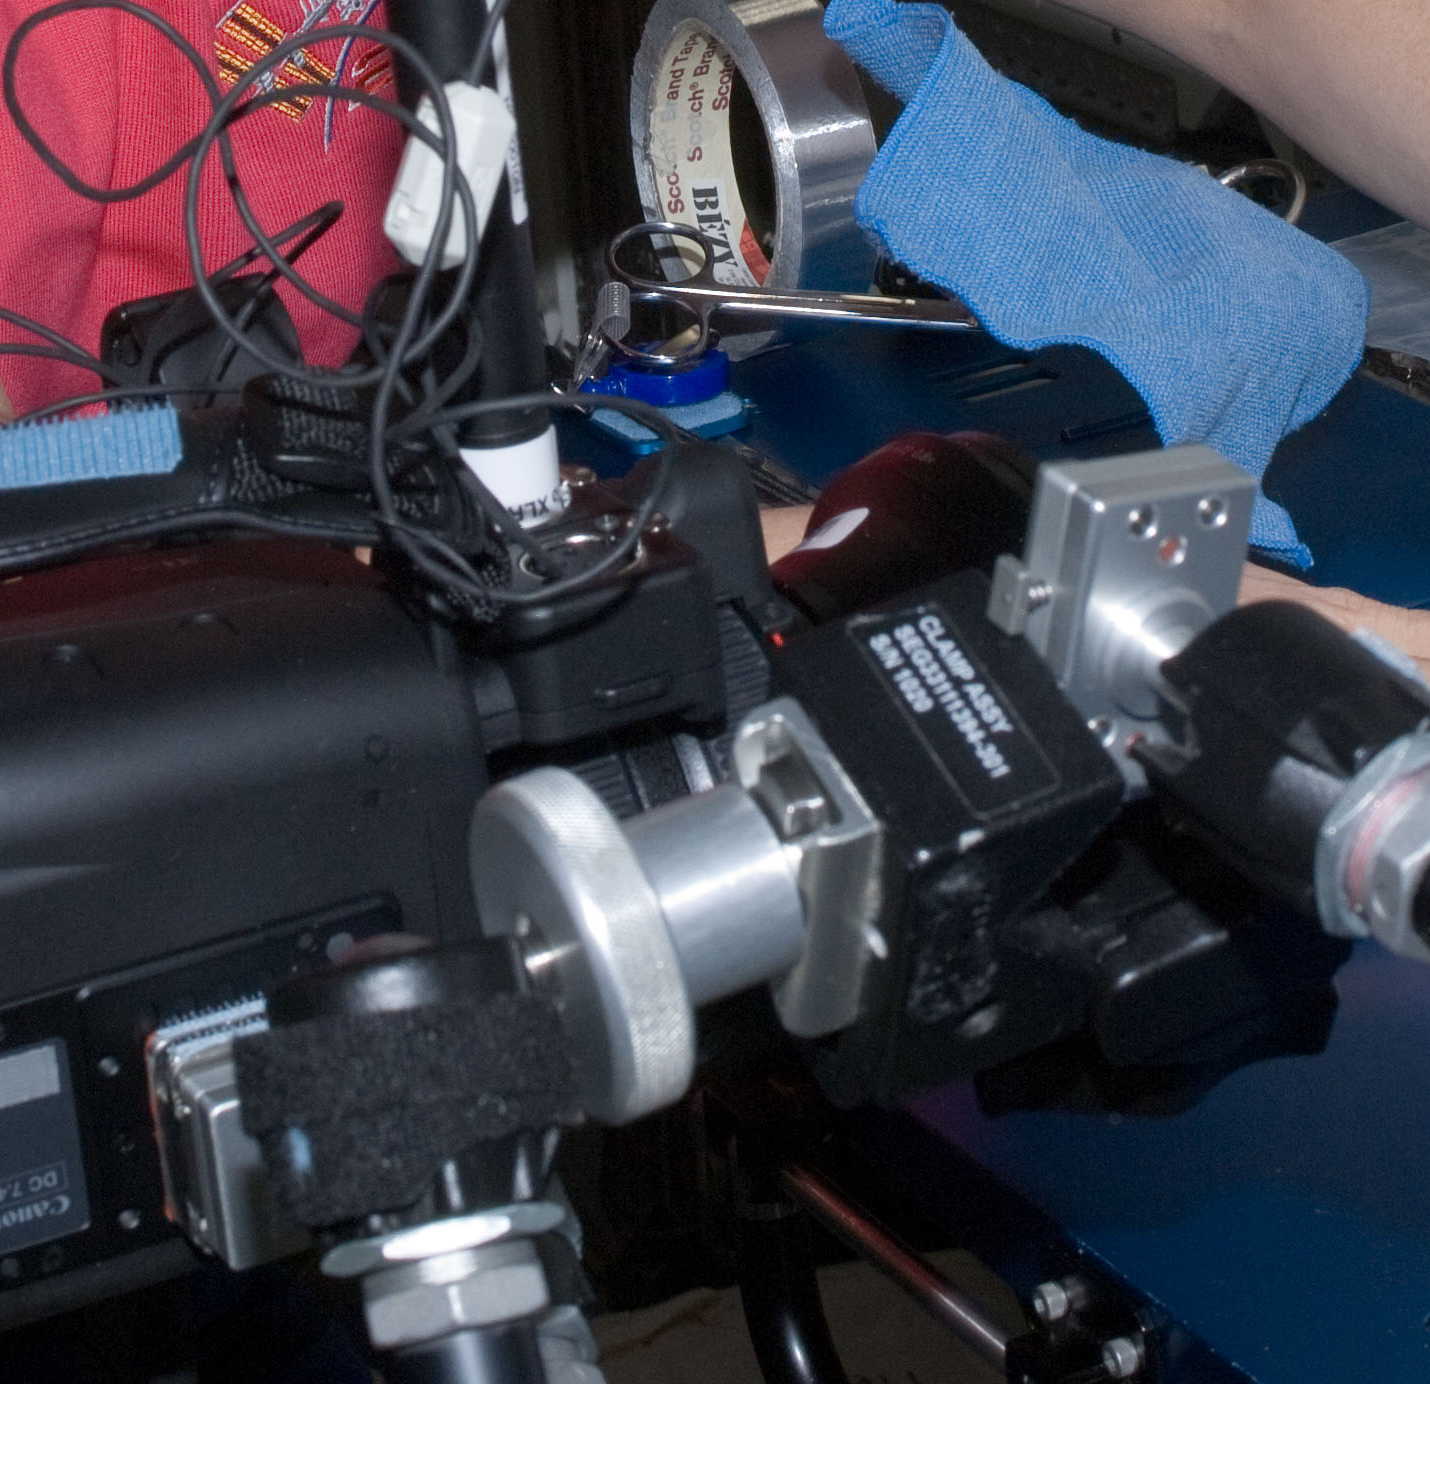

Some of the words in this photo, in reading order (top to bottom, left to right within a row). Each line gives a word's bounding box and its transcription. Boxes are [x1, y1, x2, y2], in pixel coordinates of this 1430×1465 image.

[692, 35, 720, 78] Bran
[869, 632, 906, 670] S/N
[919, 614, 976, 681] CLAMP
[962, 682, 1014, 733] ASSY
[29, 1170, 59, 1193] DC
